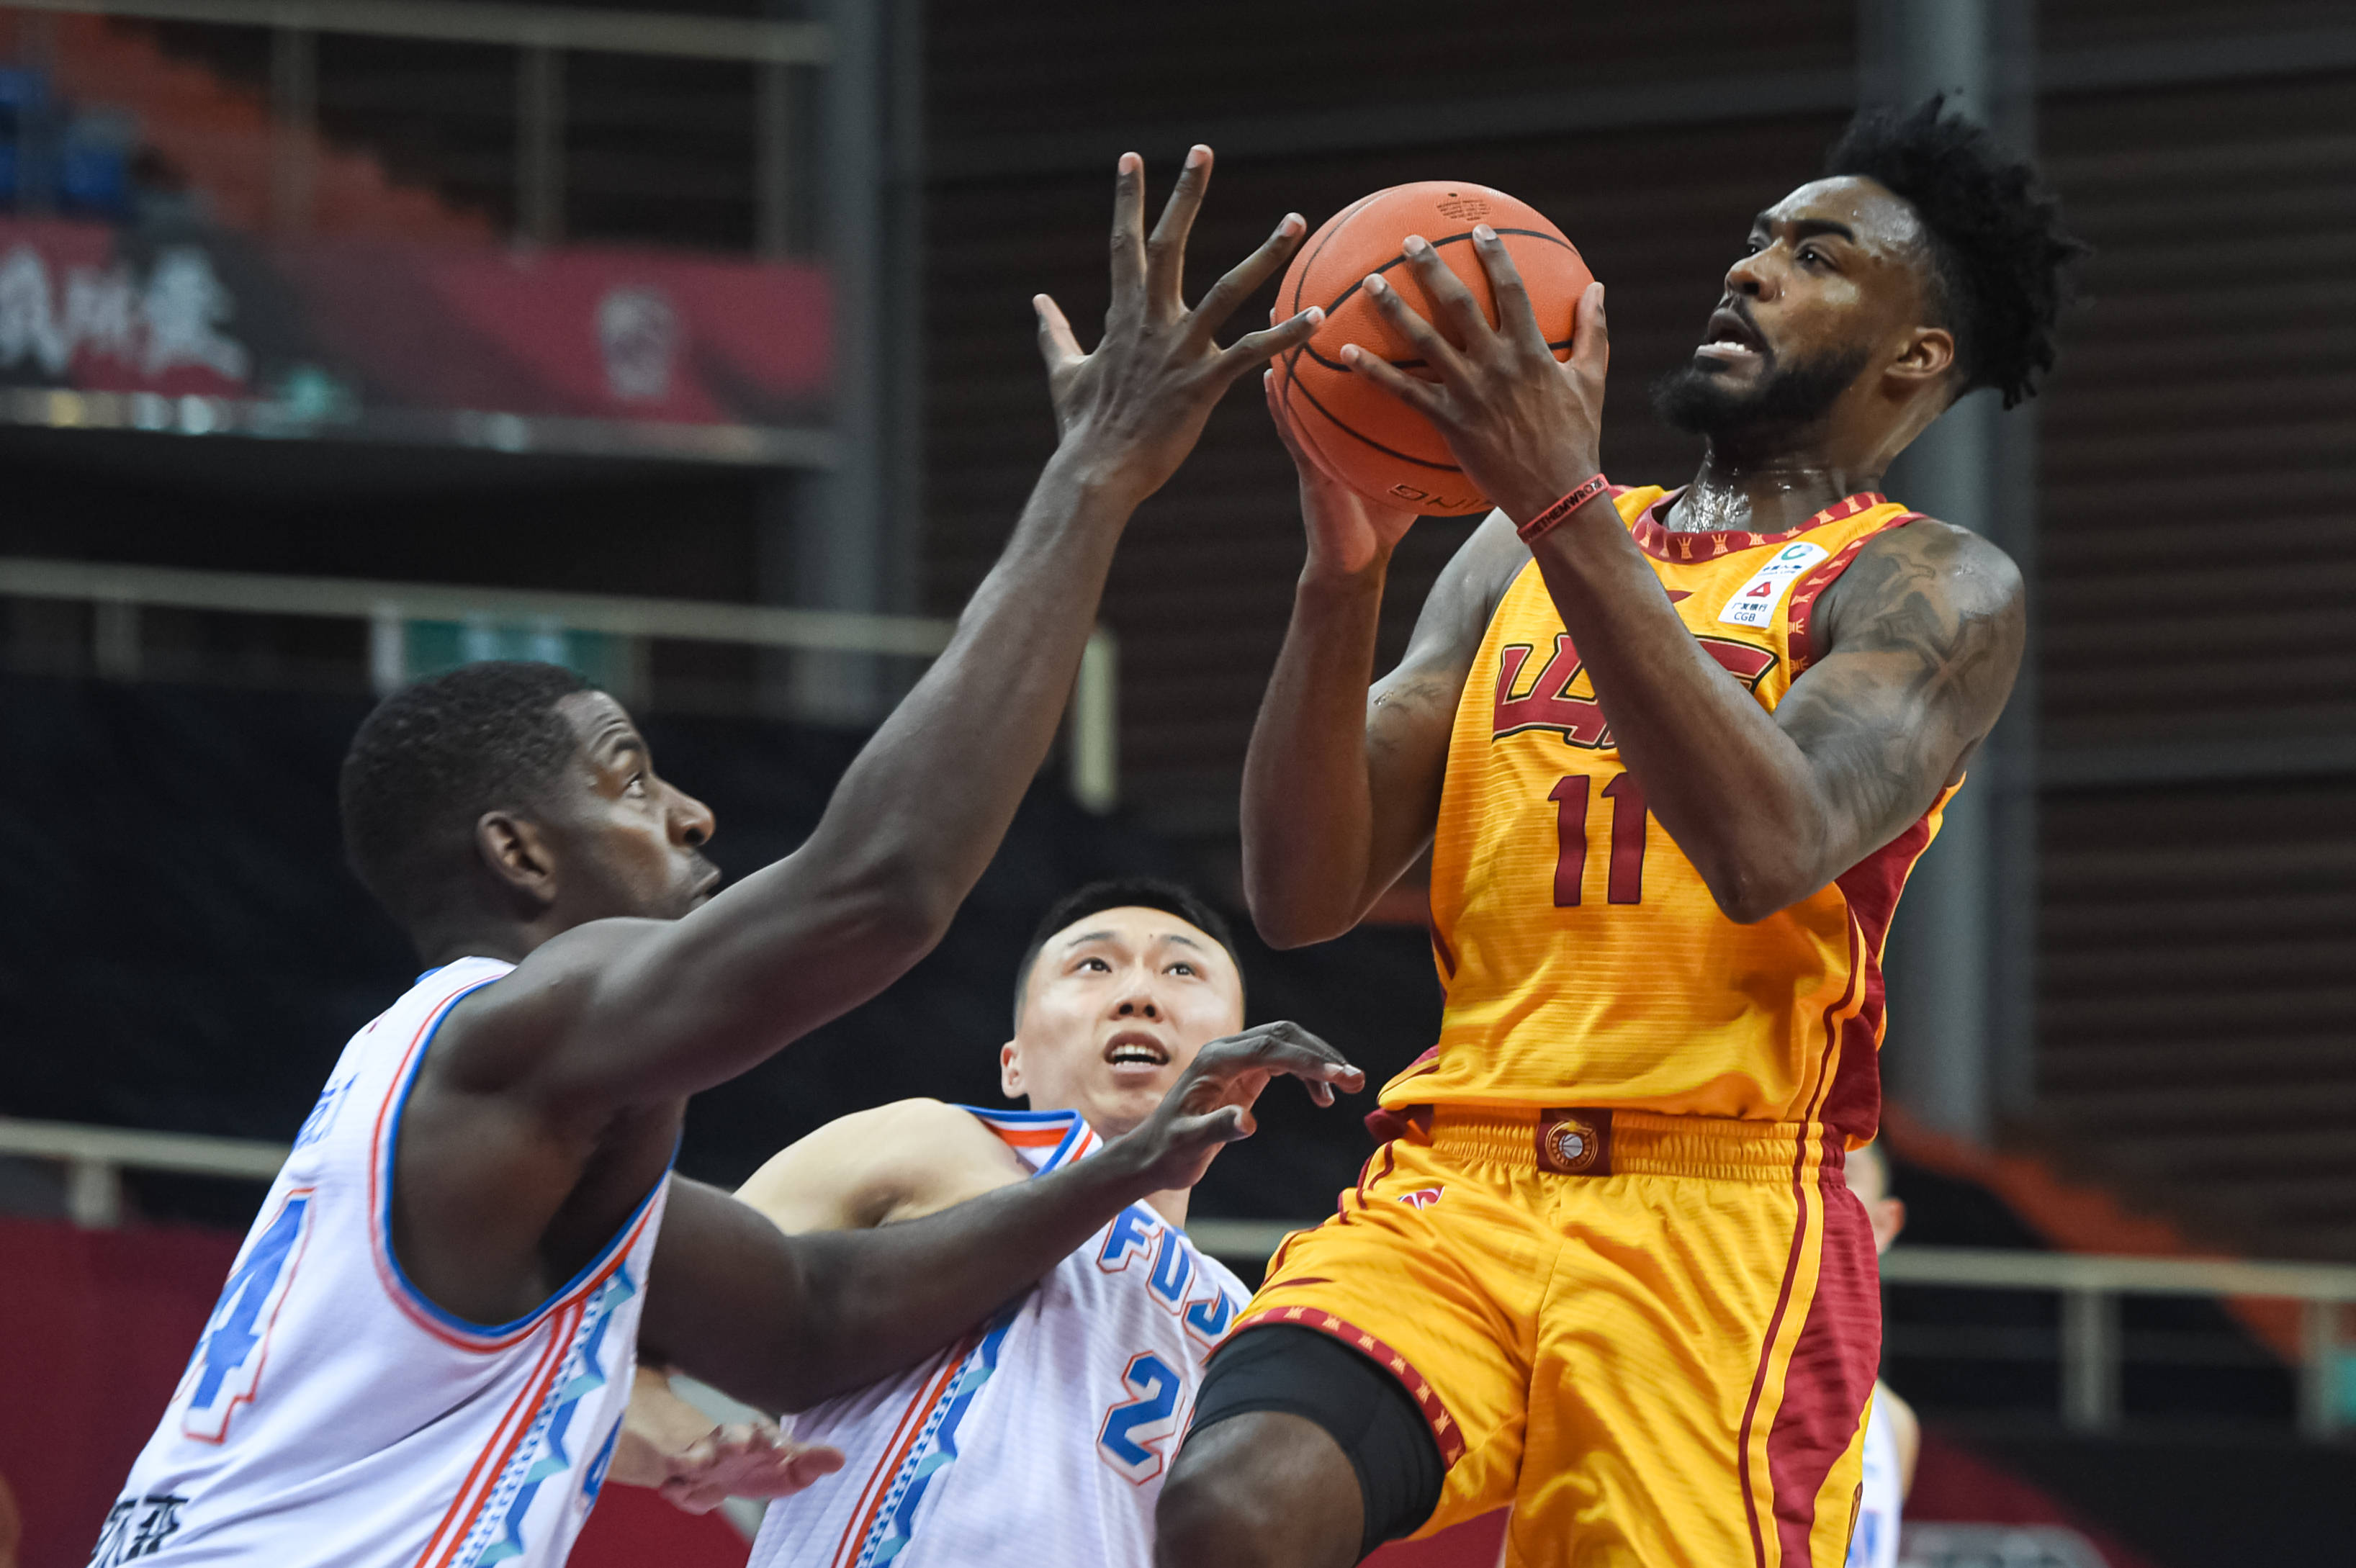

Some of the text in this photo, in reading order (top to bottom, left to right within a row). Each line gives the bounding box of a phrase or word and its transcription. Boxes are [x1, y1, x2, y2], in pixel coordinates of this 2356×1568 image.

[1734, 612, 1756, 622] CGB
[1547, 771, 1647, 907] 11
[1097, 1204, 1240, 1350] FUJ
[1096, 1351, 1195, 1486] 2
